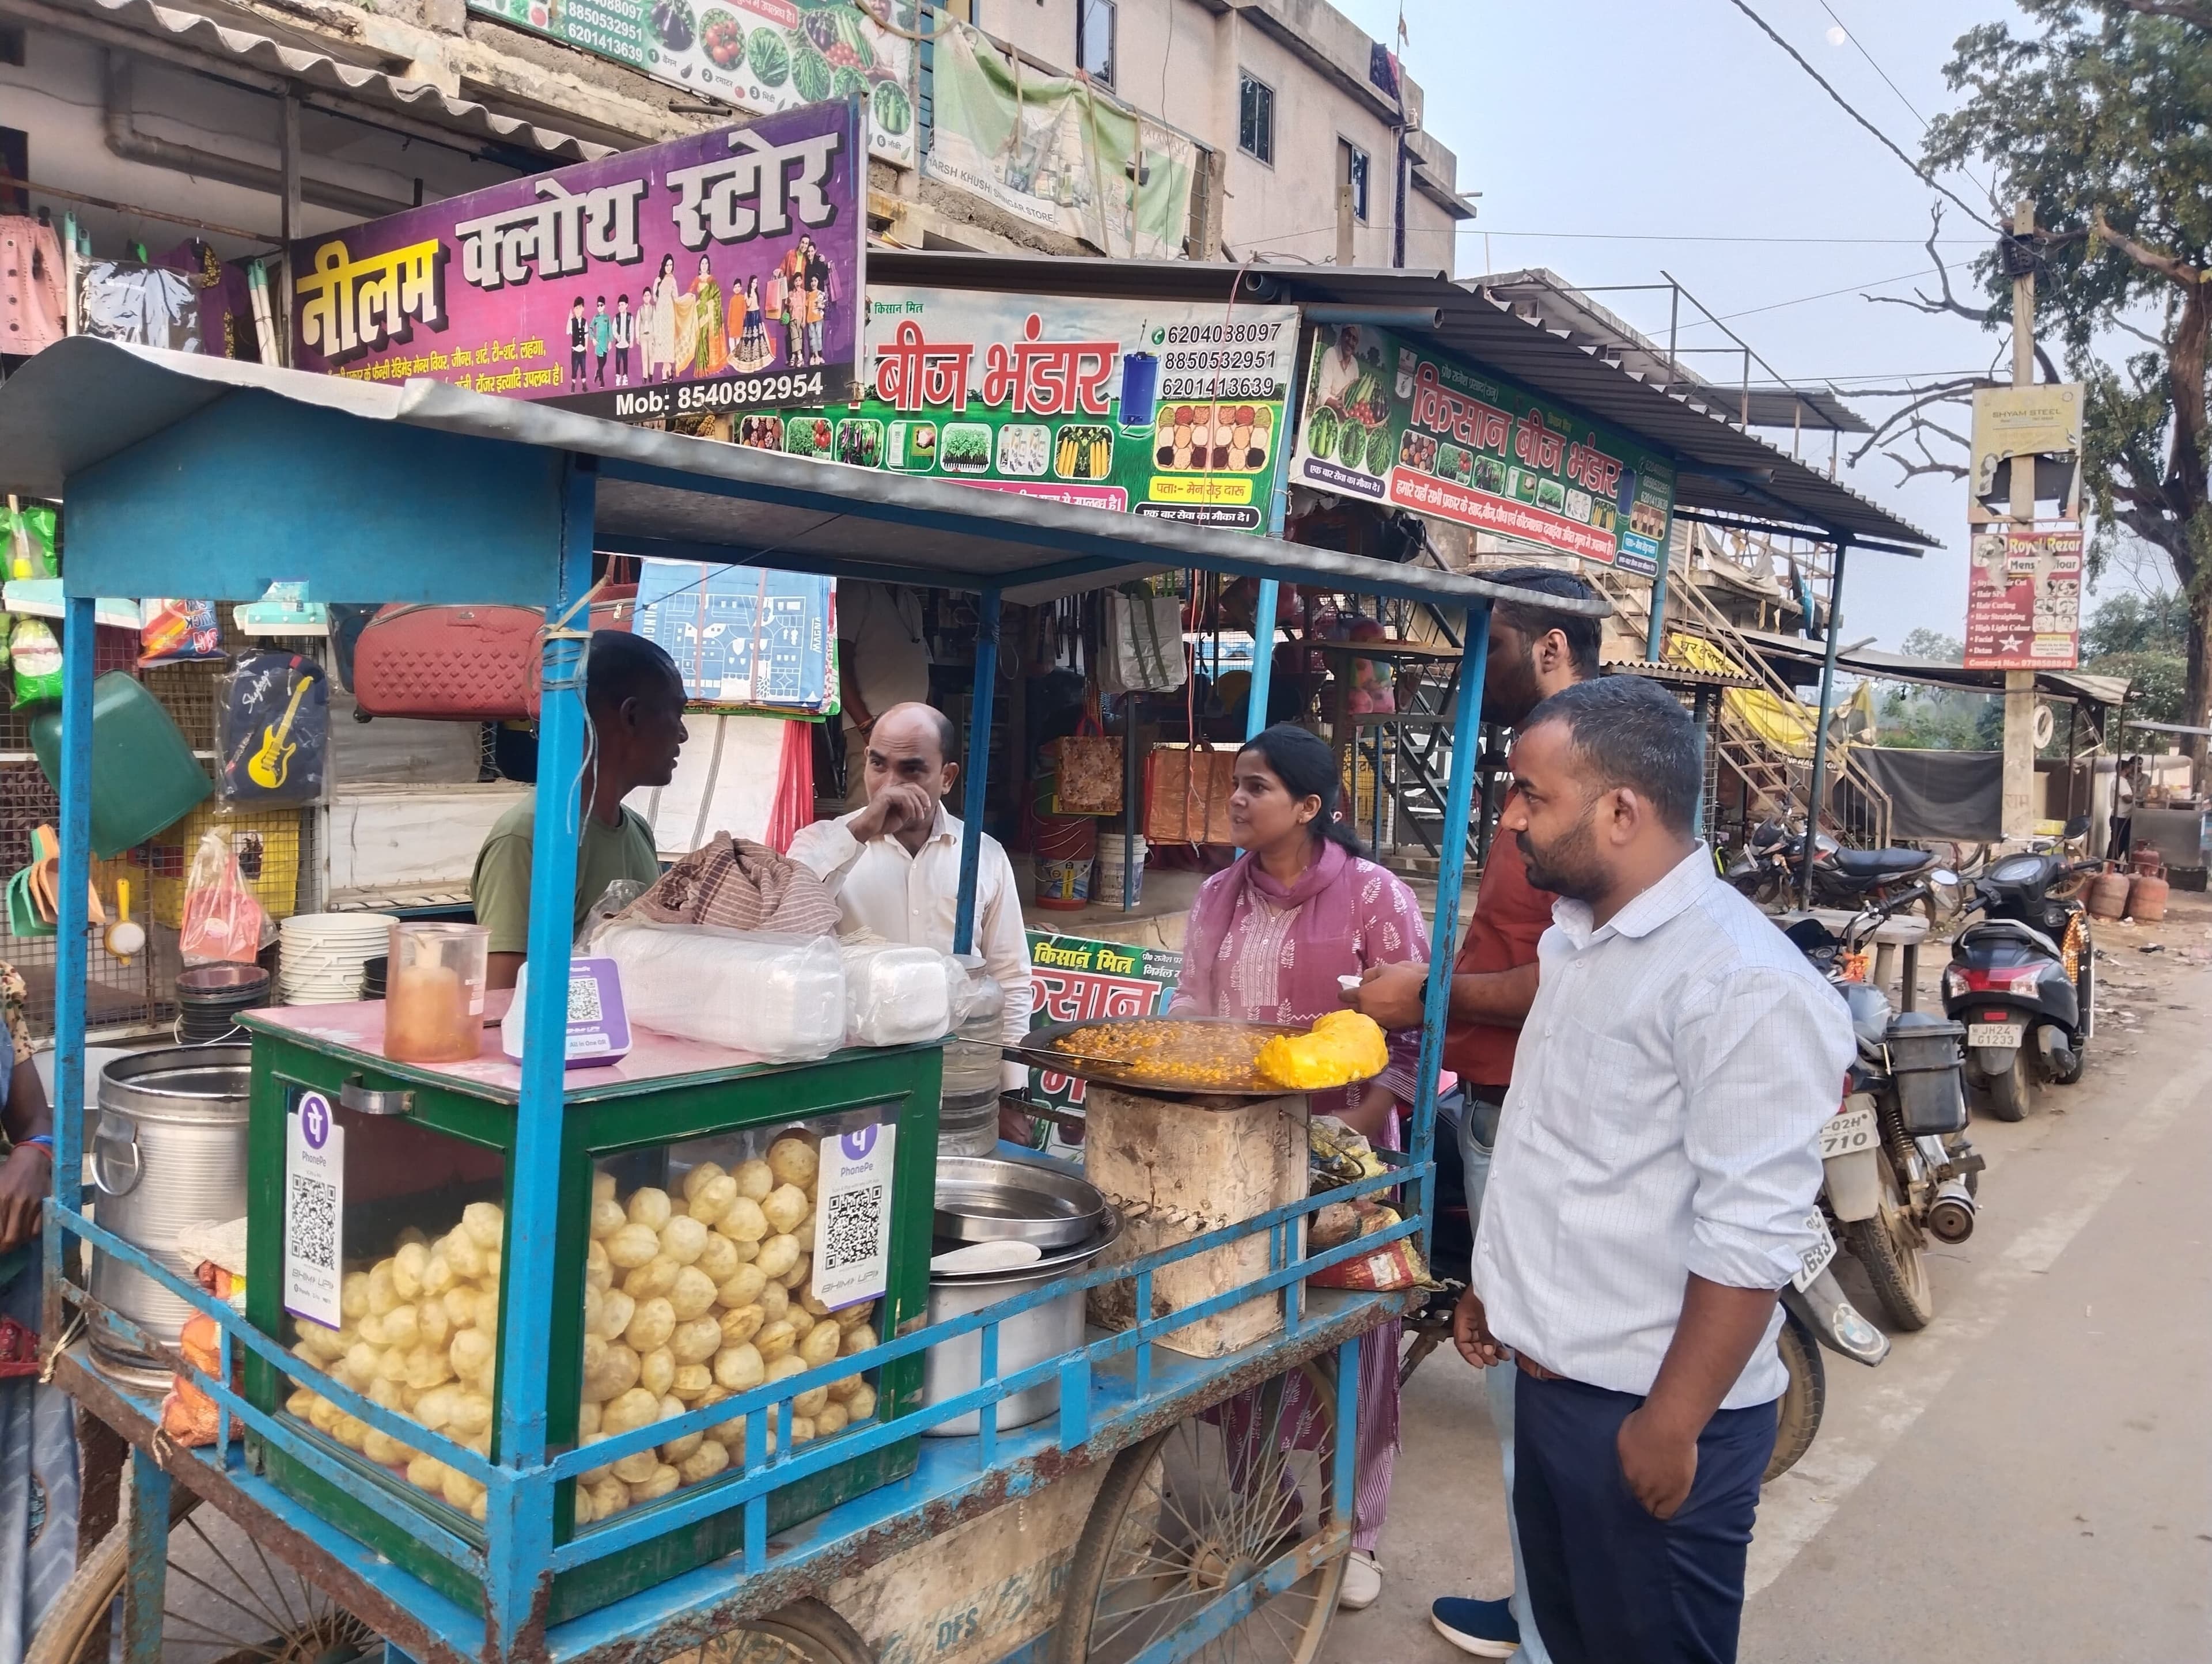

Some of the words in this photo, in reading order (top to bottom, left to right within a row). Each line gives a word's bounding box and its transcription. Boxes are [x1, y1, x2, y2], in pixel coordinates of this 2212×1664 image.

[569, 2, 643, 42] 8850532951
[568, 22, 643, 63] 6201413639
[1026, 207, 1054, 223] STORE
[296, 238, 441, 357] नीलम
[455, 177, 643, 290] क्लोथ
[666, 128, 839, 248] स्टोर
[874, 301, 903, 314] किसान
[1168, 323, 1282, 344] 6204088097
[451, 346, 474, 367] जीन्स,
[476, 342, 490, 365] शर्ट,
[491, 337, 518, 363] टी-शर्ट,
[520, 335, 546, 359] लहंगा,
[1165, 350, 1276, 370] 8850532951
[875, 318, 976, 412] बीज
[982, 312, 1121, 416] भंडार
[497, 366, 521, 393] इत्यादि
[523, 369, 551, 388] उपलब्ध
[553, 361, 563, 387] है।
[1162, 377, 1275, 397] 6201413639
[615, 390, 670, 417] Mob:
[677, 376, 824, 410] 8540892954
[1992, 410, 2027, 418] SHYAM
[2029, 408, 2062, 416] STEEL
[1411, 361, 1514, 457] किसान
[1515, 407, 1567, 477] बीज
[1567, 431, 1624, 499] भंडार
[1309, 464, 1322, 475] एक
[1334, 470, 1347, 482] सेवा
[1347, 476, 1356, 486] का
[1356, 477, 1372, 490] मौका
[1187, 482, 1204, 496] मेन
[1224, 485, 1246, 496] दारू
[1396, 479, 1415, 498] हमारे
[1414, 484, 1429, 502] यहाँ
[1427, 487, 1443, 507] सभी
[1442, 494, 1460, 511] प्रकार
[1460, 495, 1468, 513] के
[1177, 510, 1195, 520] सेवा
[1196, 512, 1210, 520] का
[1211, 510, 1235, 522] मौका
[1237, 511, 1250, 522] दे।
[2009, 537, 2044, 555] Royl
[2010, 560, 2035, 570] Mens
[1969, 659, 2002, 667] Contact
[1033, 942, 1093, 969] किसान
[1154, 954, 1173, 964] राजेश
[1143, 964, 1173, 978] निर्मल
[1982, 1025, 2011, 1035] JH24
[1819, 1132, 1868, 1153] 710
[302, 1150, 327, 1167] PhonePe
[840, 1162, 874, 1177] PhonePe
